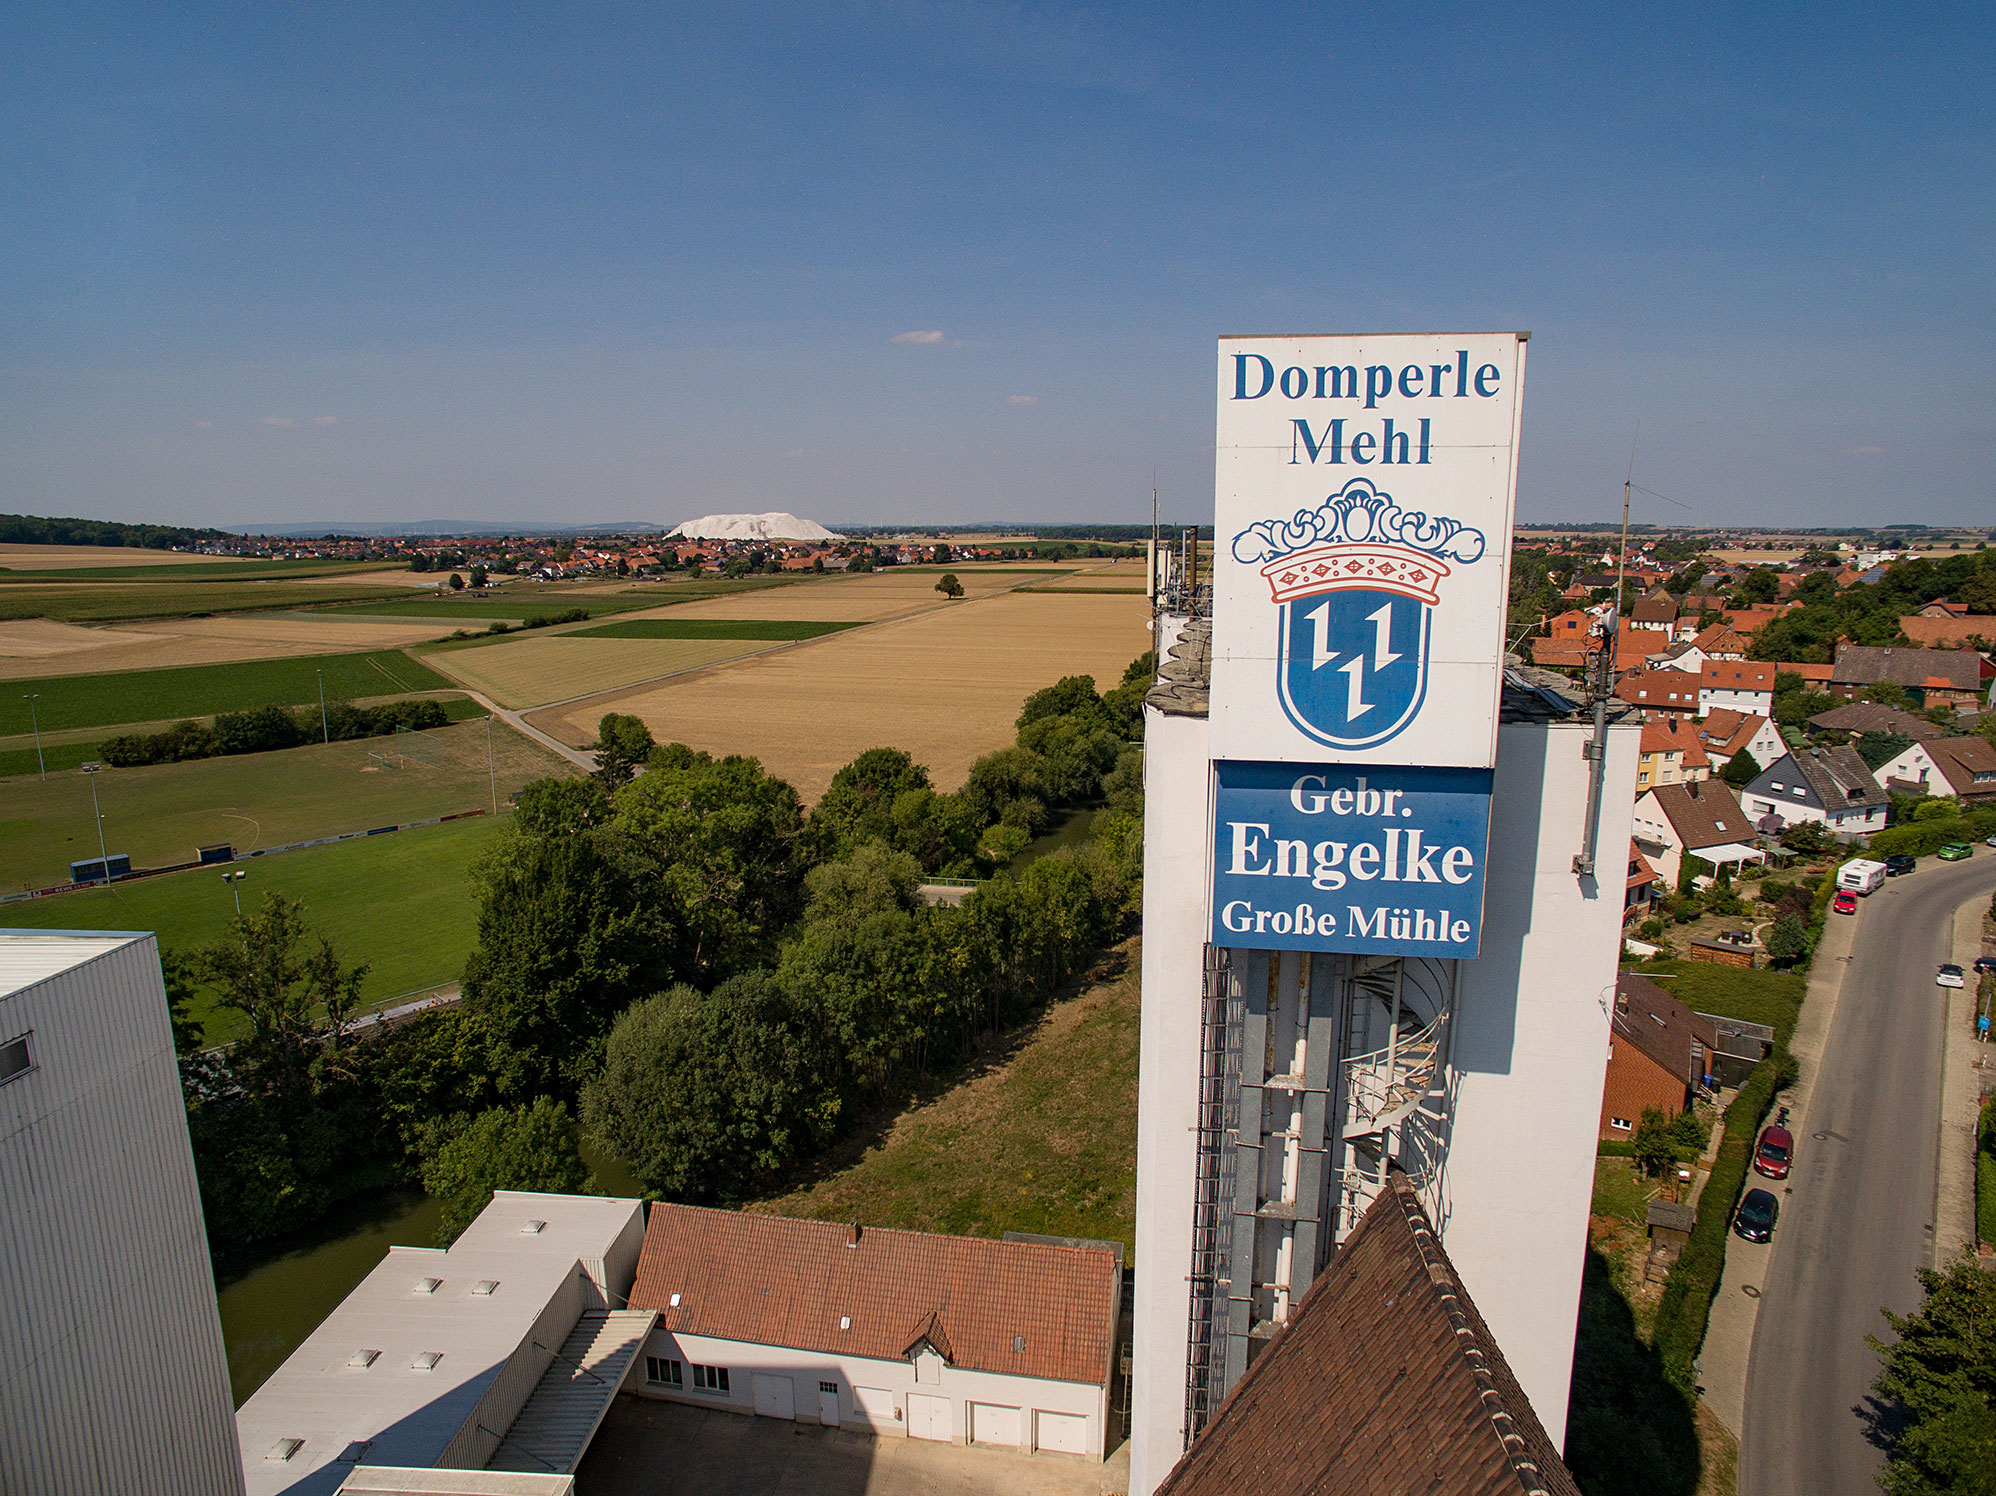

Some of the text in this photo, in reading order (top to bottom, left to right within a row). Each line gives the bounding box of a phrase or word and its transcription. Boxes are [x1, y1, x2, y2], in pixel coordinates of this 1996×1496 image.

[1231, 350, 1501, 408] Domperle
[1288, 418, 1432, 465] Mehl
[1290, 774, 1413, 818] Gebr.
[1225, 821, 1474, 890] Engelke
[1221, 899, 1471, 943] Große Mühle
